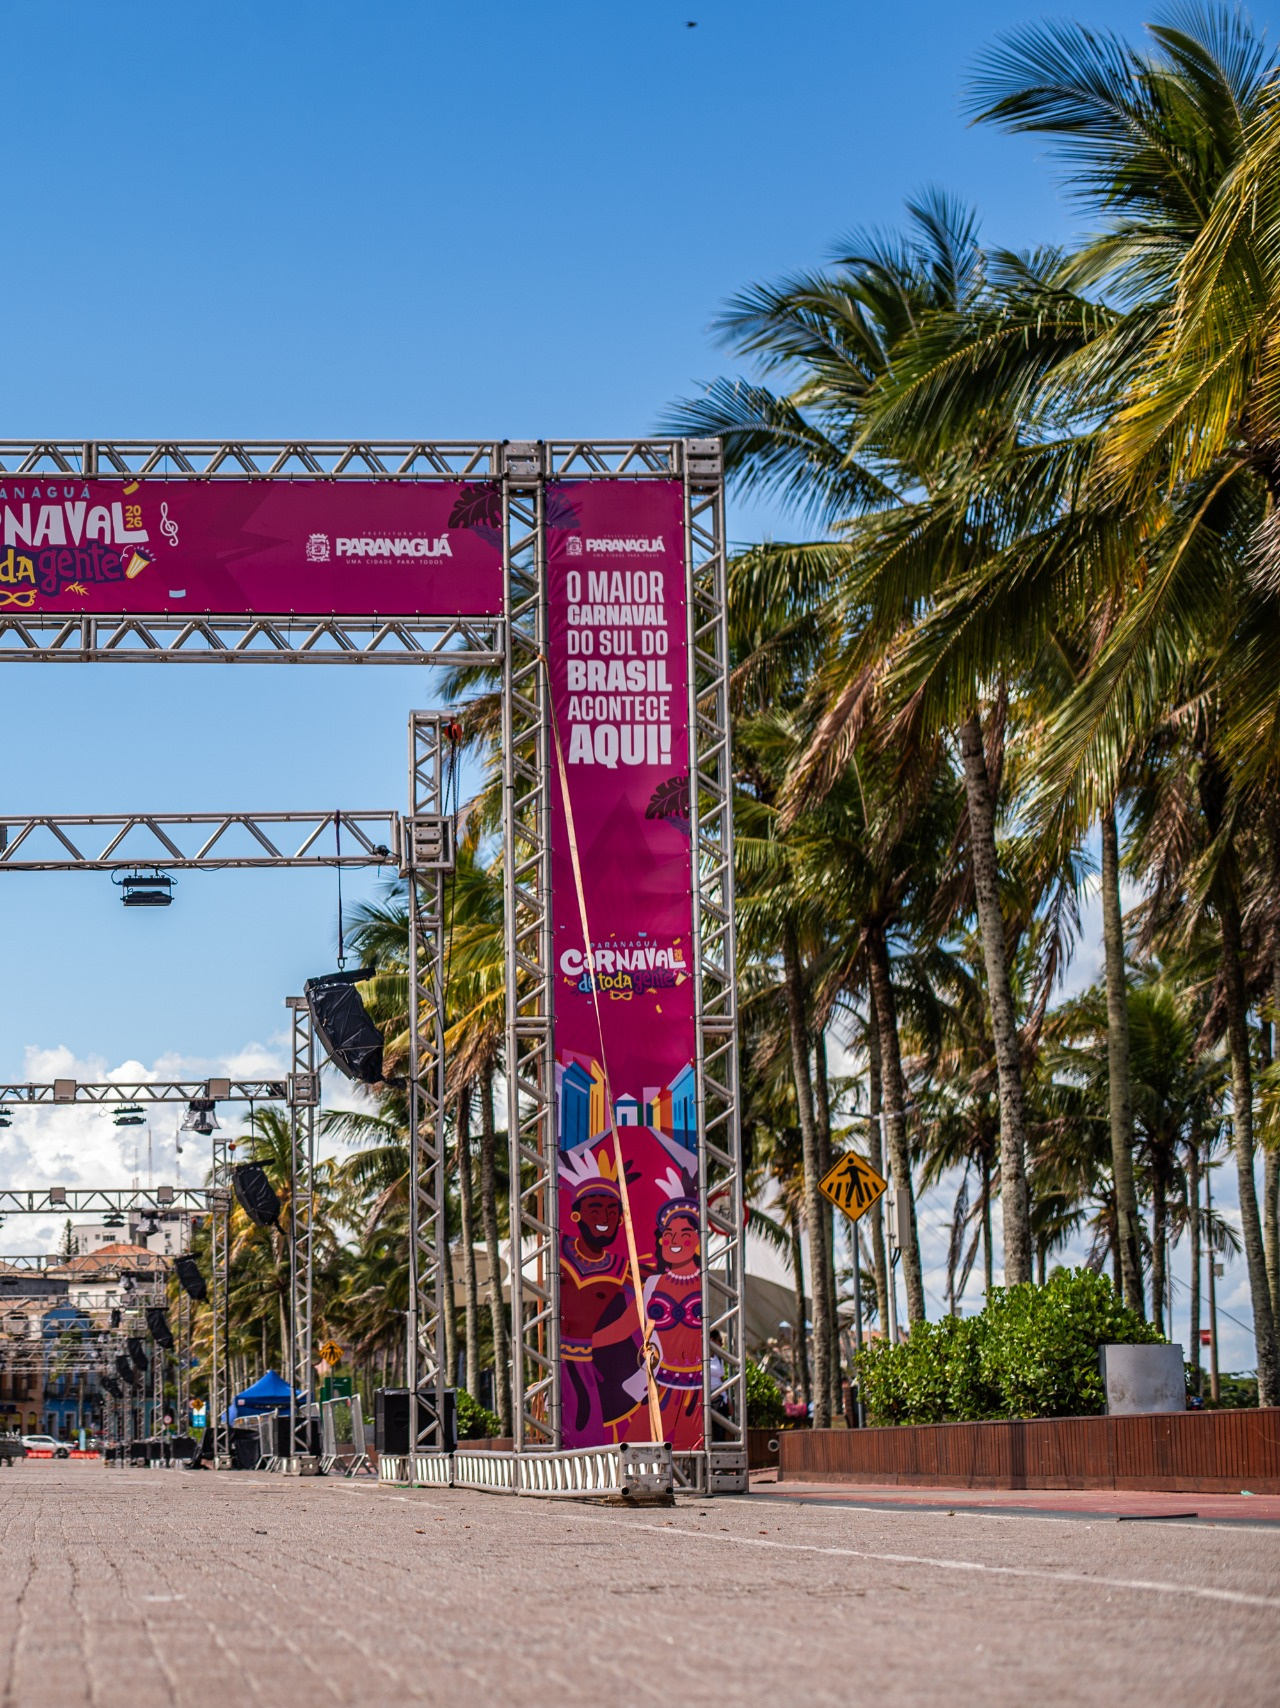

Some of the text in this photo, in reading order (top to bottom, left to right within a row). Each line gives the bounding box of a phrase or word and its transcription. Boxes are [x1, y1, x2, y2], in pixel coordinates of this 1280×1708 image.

[336, 533, 453, 557] PARANAGUÁ
[586, 535, 666, 552] PARANAGUÁ
[38, 544, 121, 593] gente
[566, 570, 665, 603] O MAIOR
[567, 604, 668, 626] CARNAVAL
[567, 630, 669, 655] DO SUL DO
[567, 659, 673, 692] BRASIL
[567, 695, 670, 721] ACONTECE
[568, 723, 672, 769] AQUI!
